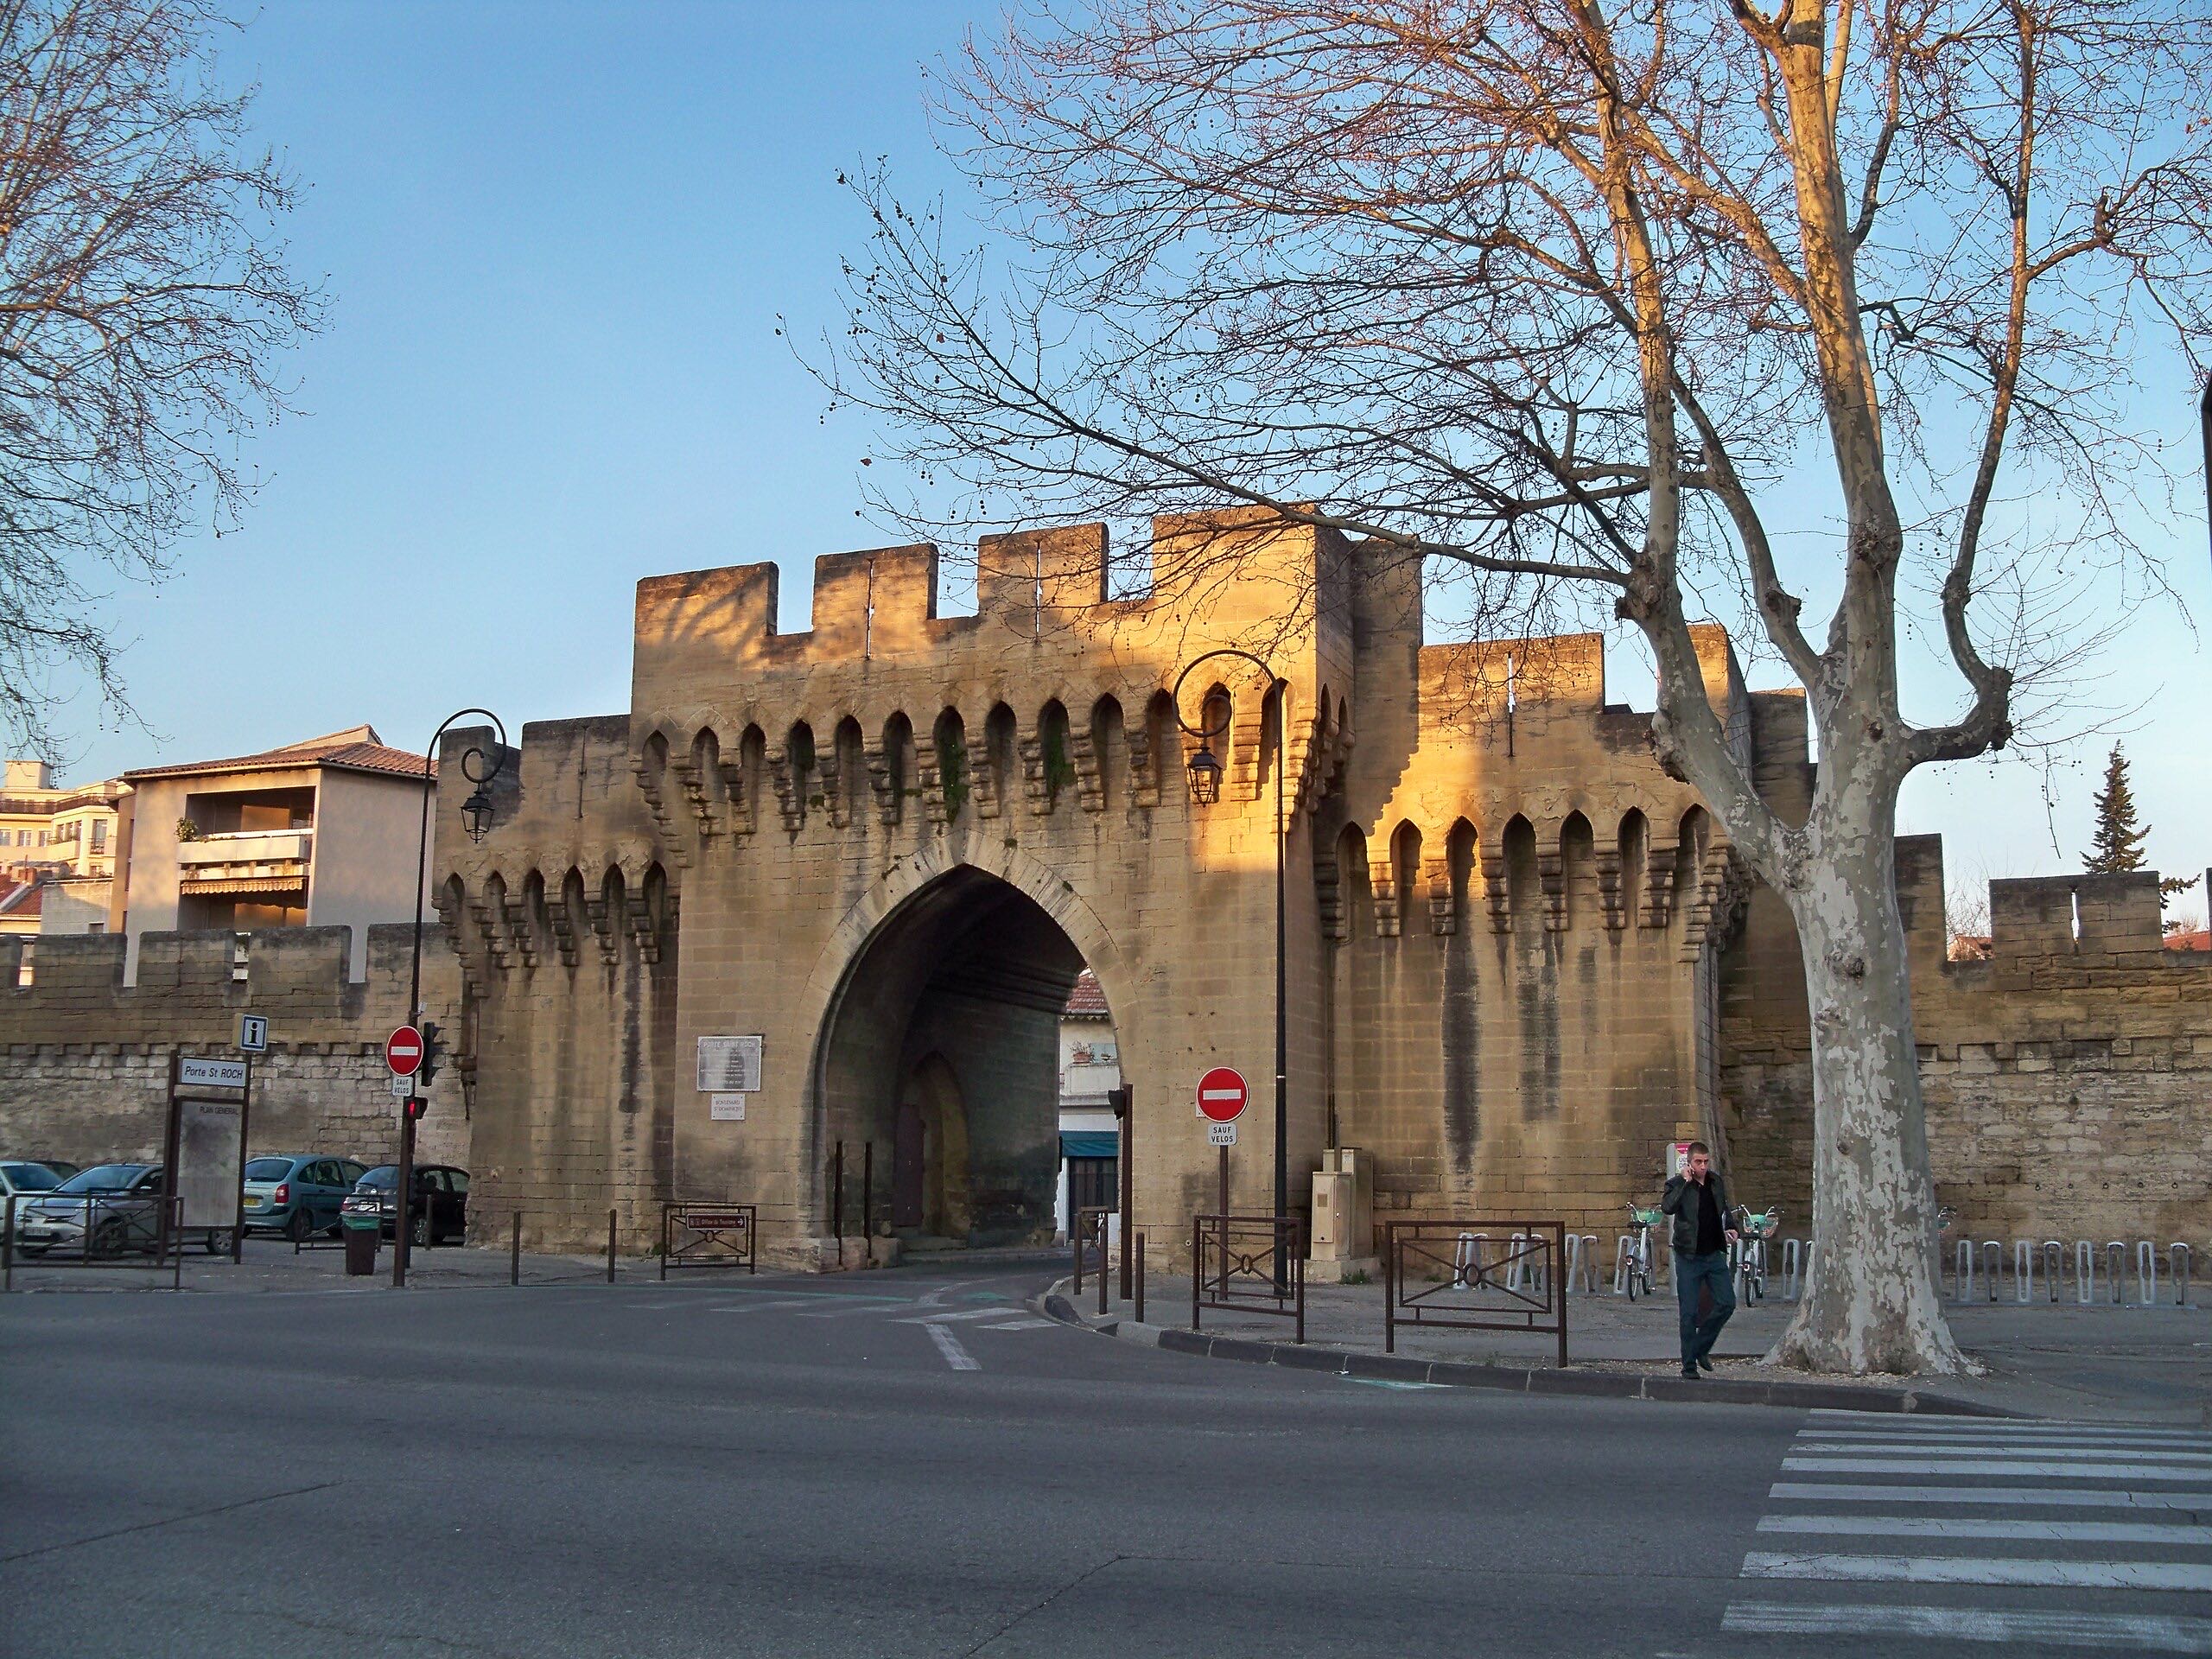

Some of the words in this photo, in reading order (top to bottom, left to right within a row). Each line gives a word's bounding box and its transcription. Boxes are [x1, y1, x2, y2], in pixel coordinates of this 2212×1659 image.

[185, 1066, 207, 1077] Porte
[209, 1067, 218, 1077] St
[220, 1069, 244, 1080] ROCH
